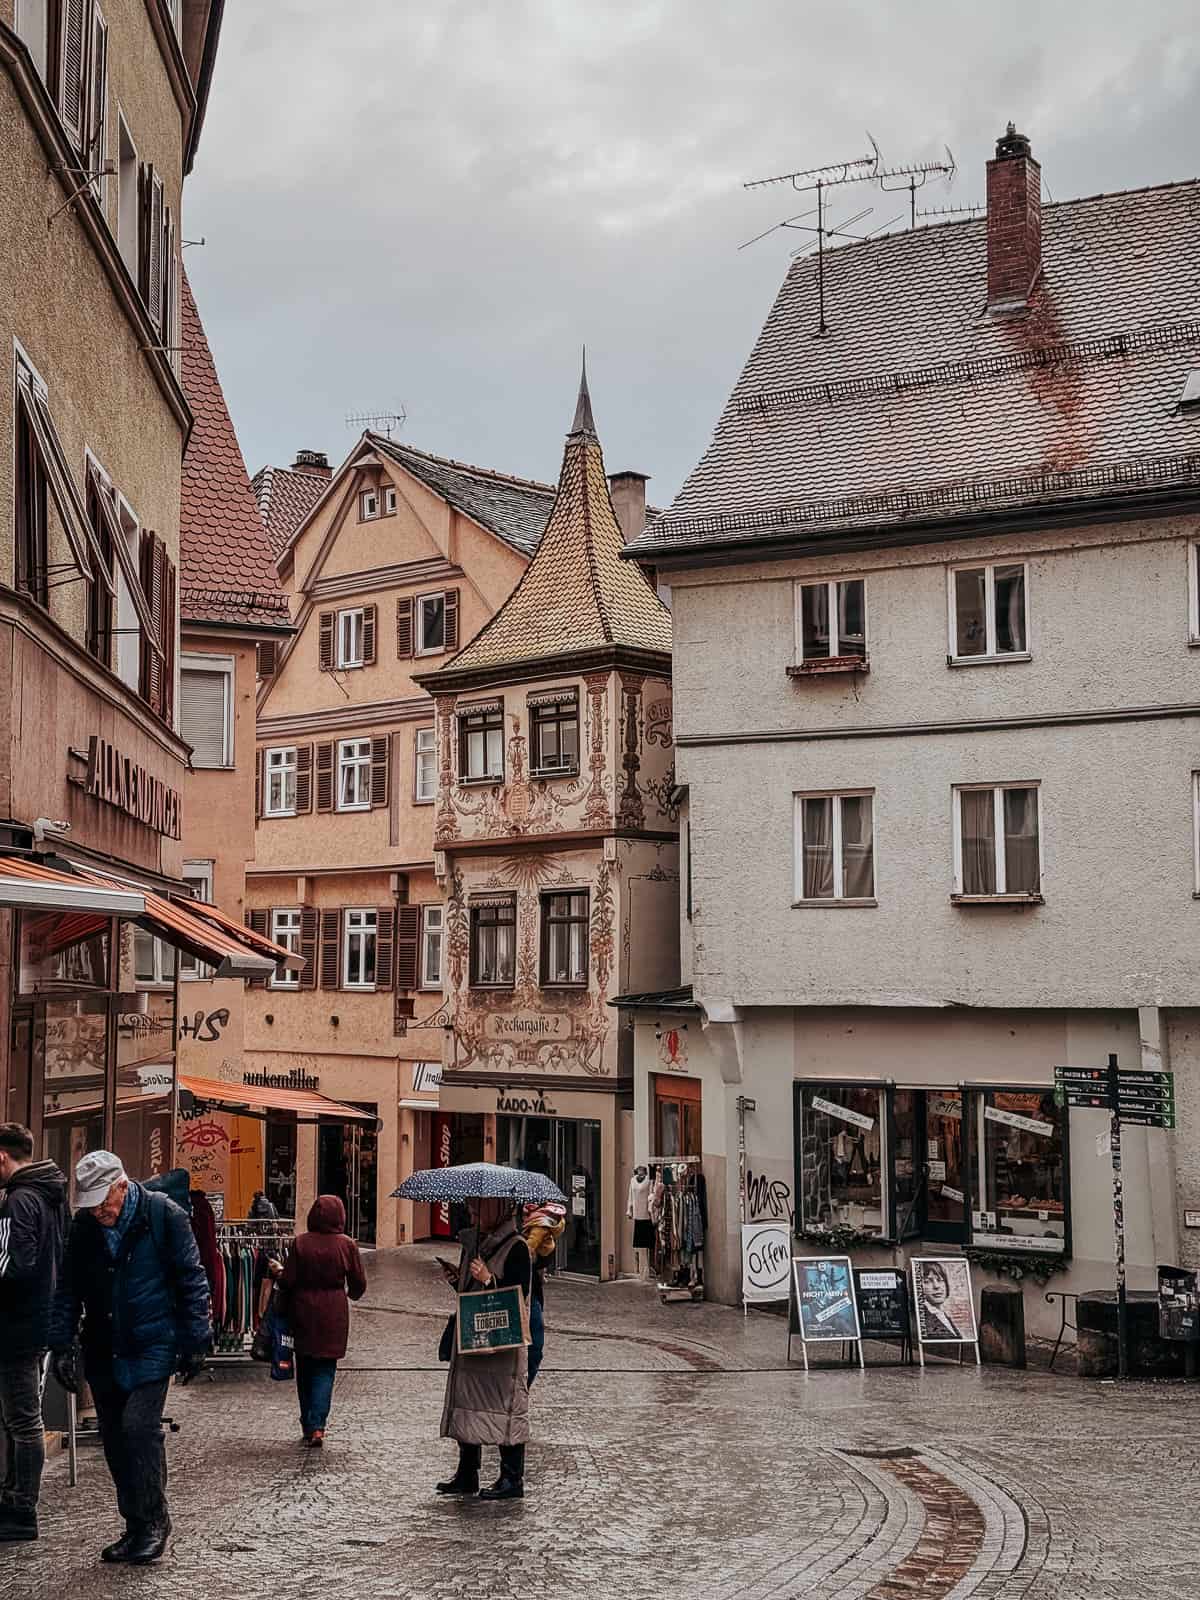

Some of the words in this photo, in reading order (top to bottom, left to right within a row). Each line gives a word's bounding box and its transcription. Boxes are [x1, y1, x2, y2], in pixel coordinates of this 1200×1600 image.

[553, 1016, 560, 1033] 2
[496, 1097, 546, 1113] KADO-YA
[749, 1241, 788, 1274] Offen
